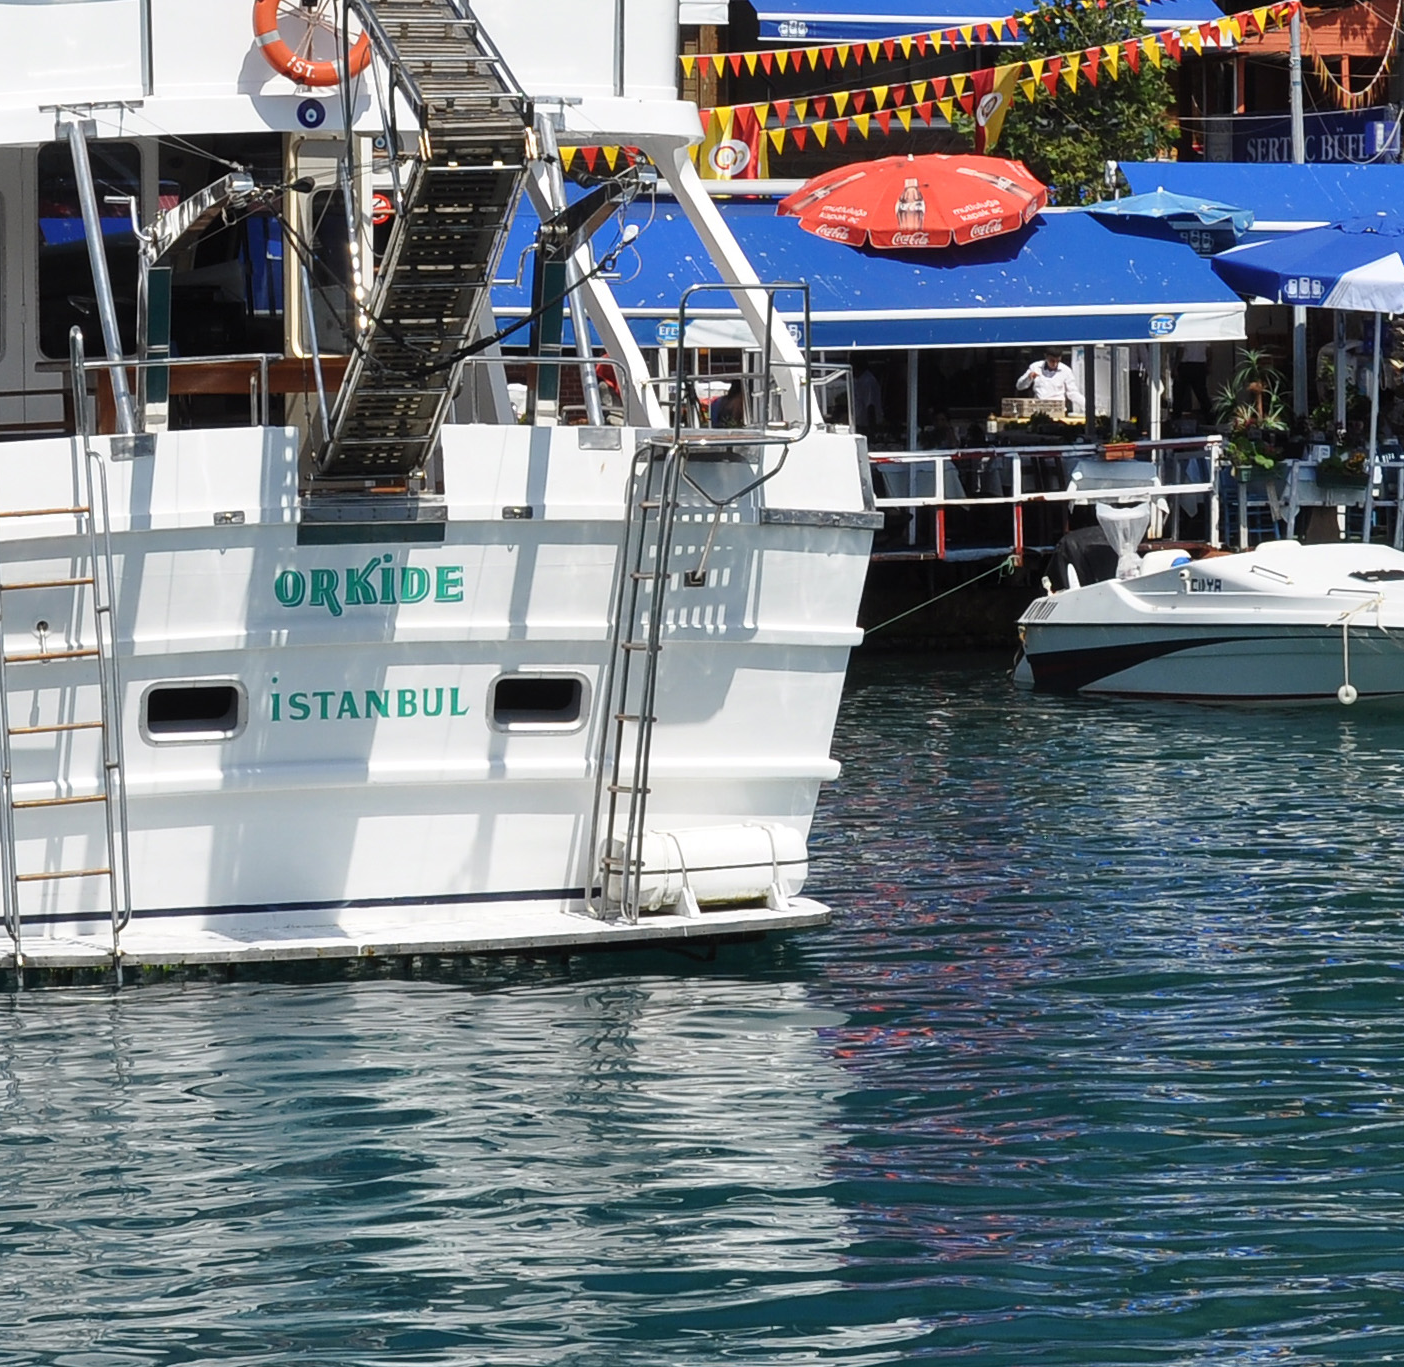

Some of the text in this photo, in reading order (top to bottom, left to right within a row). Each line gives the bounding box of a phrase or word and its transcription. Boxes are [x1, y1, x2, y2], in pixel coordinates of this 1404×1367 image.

[953, 199, 1000, 215] mutluluğa
[960, 209, 990, 221] kapak
[659, 326, 679, 336] EFE
[274, 553, 464, 617] ORKİDE
[270, 677, 470, 722] İSTANBUL
